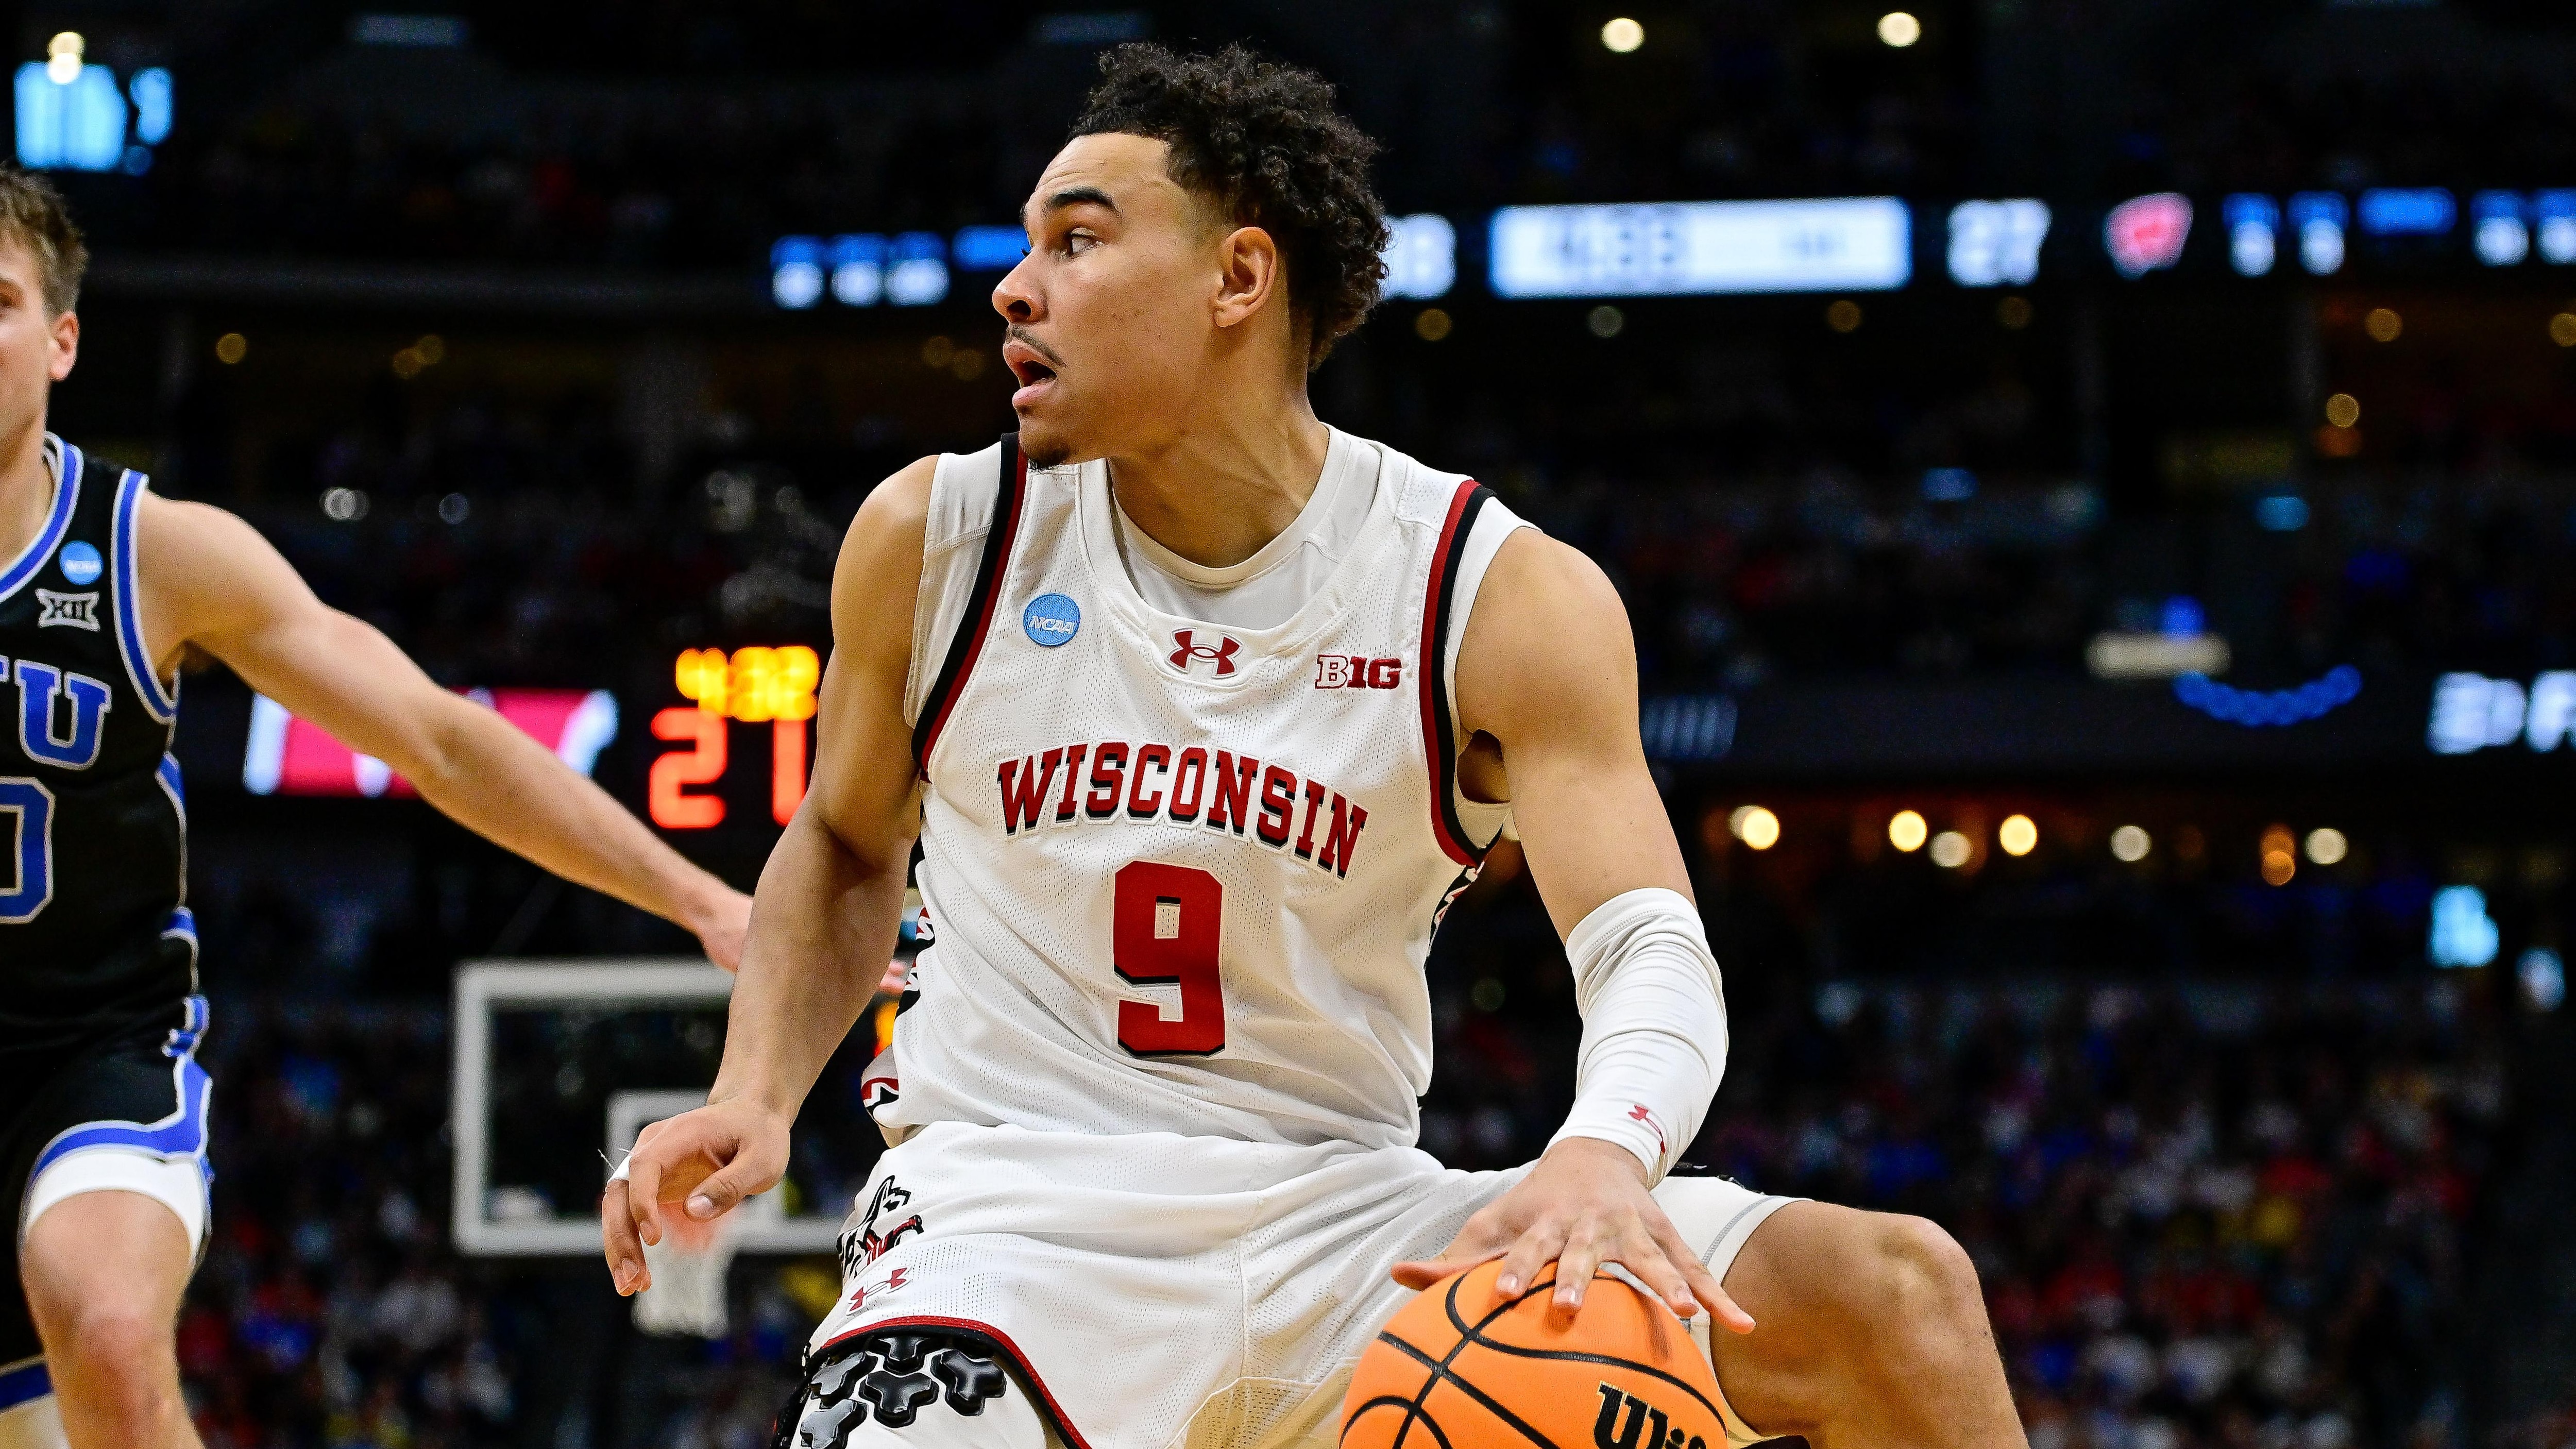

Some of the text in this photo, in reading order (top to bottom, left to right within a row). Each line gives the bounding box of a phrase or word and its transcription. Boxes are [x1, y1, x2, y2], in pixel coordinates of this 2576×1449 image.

[1028, 615, 1075, 635] NCAA
[0, 654, 112, 771] U
[997, 742, 1368, 880] WISCONSIN
[1113, 860, 1226, 1057] 9
